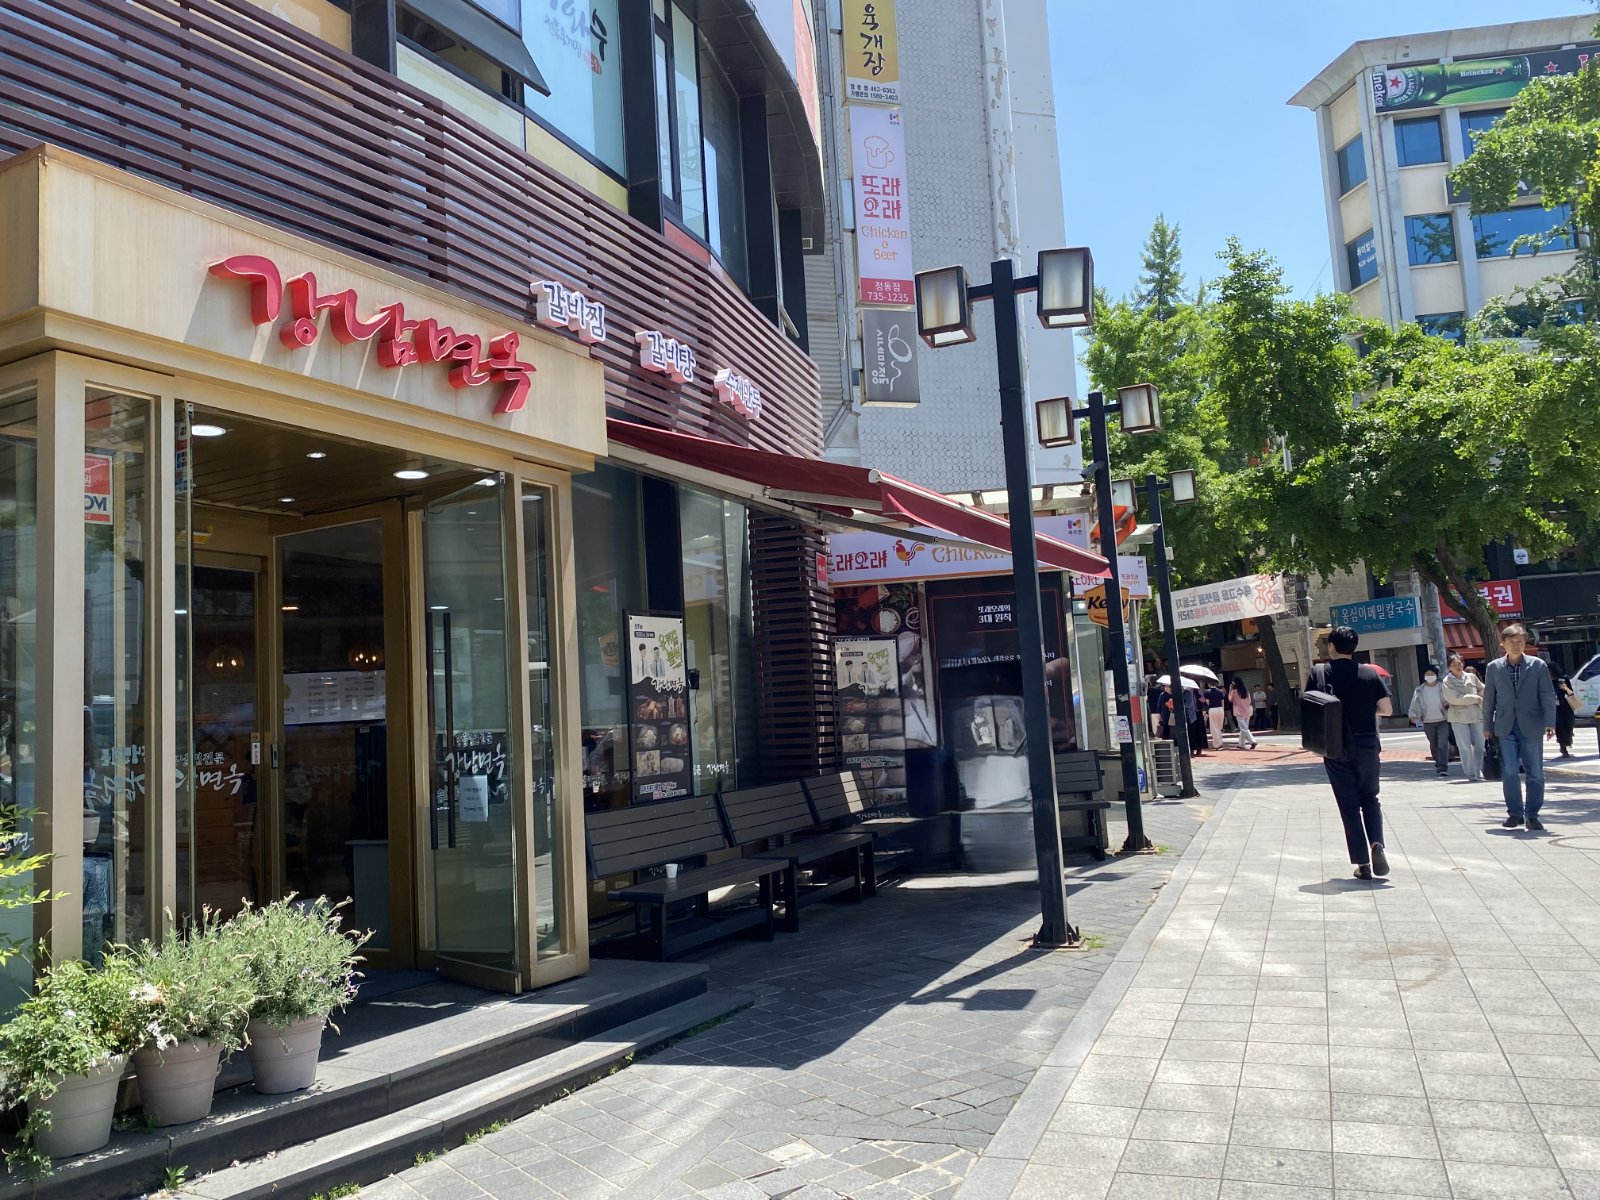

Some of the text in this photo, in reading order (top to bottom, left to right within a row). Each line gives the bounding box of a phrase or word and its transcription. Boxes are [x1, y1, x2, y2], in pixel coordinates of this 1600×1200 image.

[860, 3, 886, 77] 육개장
[1460, 67, 1494, 78] Heineken
[861, 174, 902, 197] 또래
[863, 197, 902, 220] 오래
[861, 225, 908, 240] Chicken
[873, 248, 898, 261] Beer
[866, 291, 909, 303] 735-1235
[874, 281, 901, 293] 정동점
[540, 280, 606, 342] 갈비찜
[208, 255, 536, 415] 강남면옥
[645, 331, 696, 382] 갈비탕
[722, 368, 762, 419] 수제만두
[978, 612, 1012, 624] 3대 원칙
[1341, 599, 1415, 625] 옹심이메밀칼국수
[651, 677, 684, 694] 강남면옥
[445, 743, 506, 780] 강남면옥
[706, 760, 730, 778] 강남면옥
